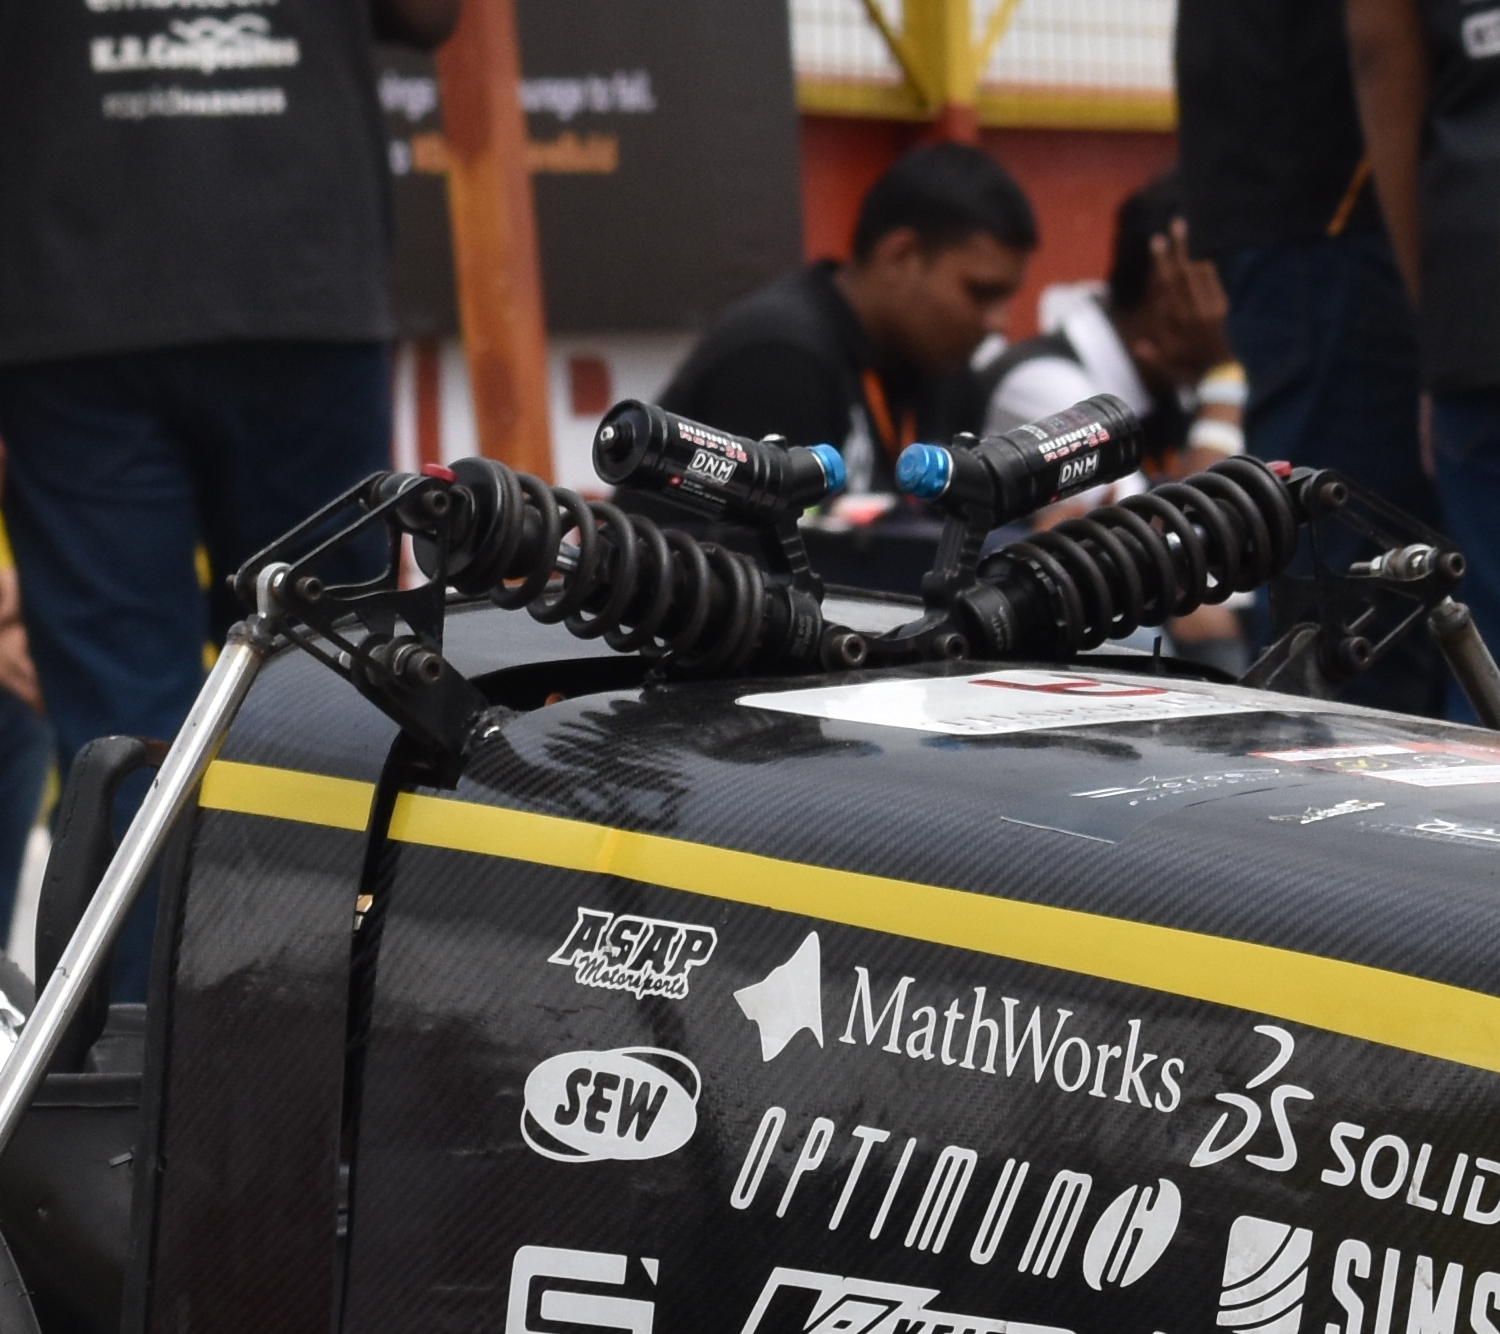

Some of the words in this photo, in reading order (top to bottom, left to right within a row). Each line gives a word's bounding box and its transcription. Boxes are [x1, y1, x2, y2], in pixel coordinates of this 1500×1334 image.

[692, 452, 735, 482] DNM
[1061, 453, 1098, 484] DNM
[548, 906, 718, 977] ASAP
[574, 952, 690, 1000] Motorsports
[838, 966, 1185, 1114] MathWorks
[553, 1067, 669, 1143] SEW
